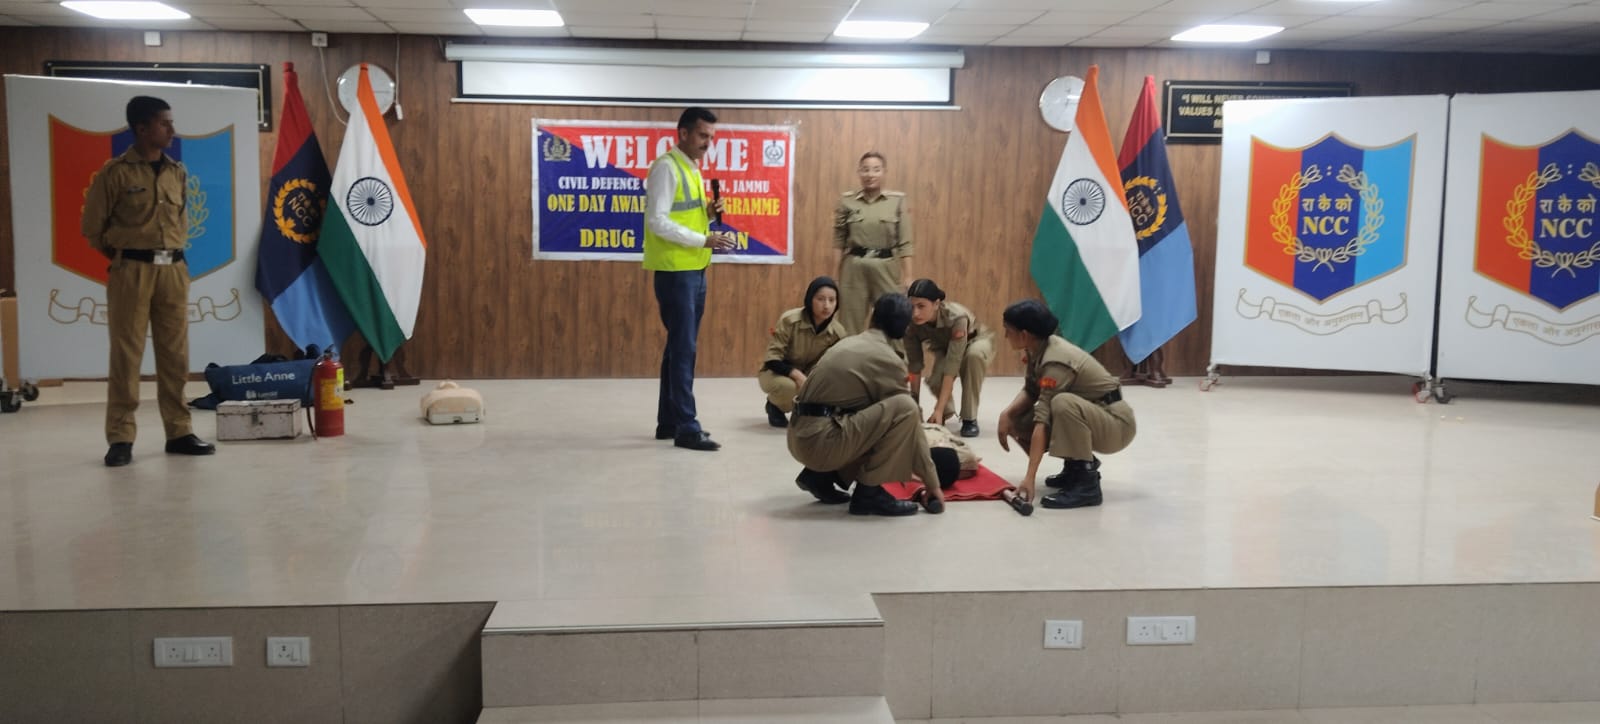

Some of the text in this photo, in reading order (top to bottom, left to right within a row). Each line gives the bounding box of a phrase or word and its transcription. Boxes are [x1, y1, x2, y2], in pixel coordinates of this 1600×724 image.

[1191, 94, 1213, 104] WILL
[1178, 106, 1213, 116] VALUES
[581, 135, 748, 171] WELCME
[558, 176, 588, 190] CIVIL
[591, 176, 640, 191] DEFENCE
[733, 180, 770, 194] JAMMU
[547, 193, 575, 212] ONE
[579, 194, 607, 213] DAY
[1302, 193, 1353, 212] रा कै को
[1540, 199, 1553, 213] रा
[1557, 193, 1572, 213] कै
[1302, 216, 1349, 236] NCC
[1539, 218, 1593, 239] NCC
[579, 228, 636, 248] DRUG
[231, 371, 296, 385] Little Anne
